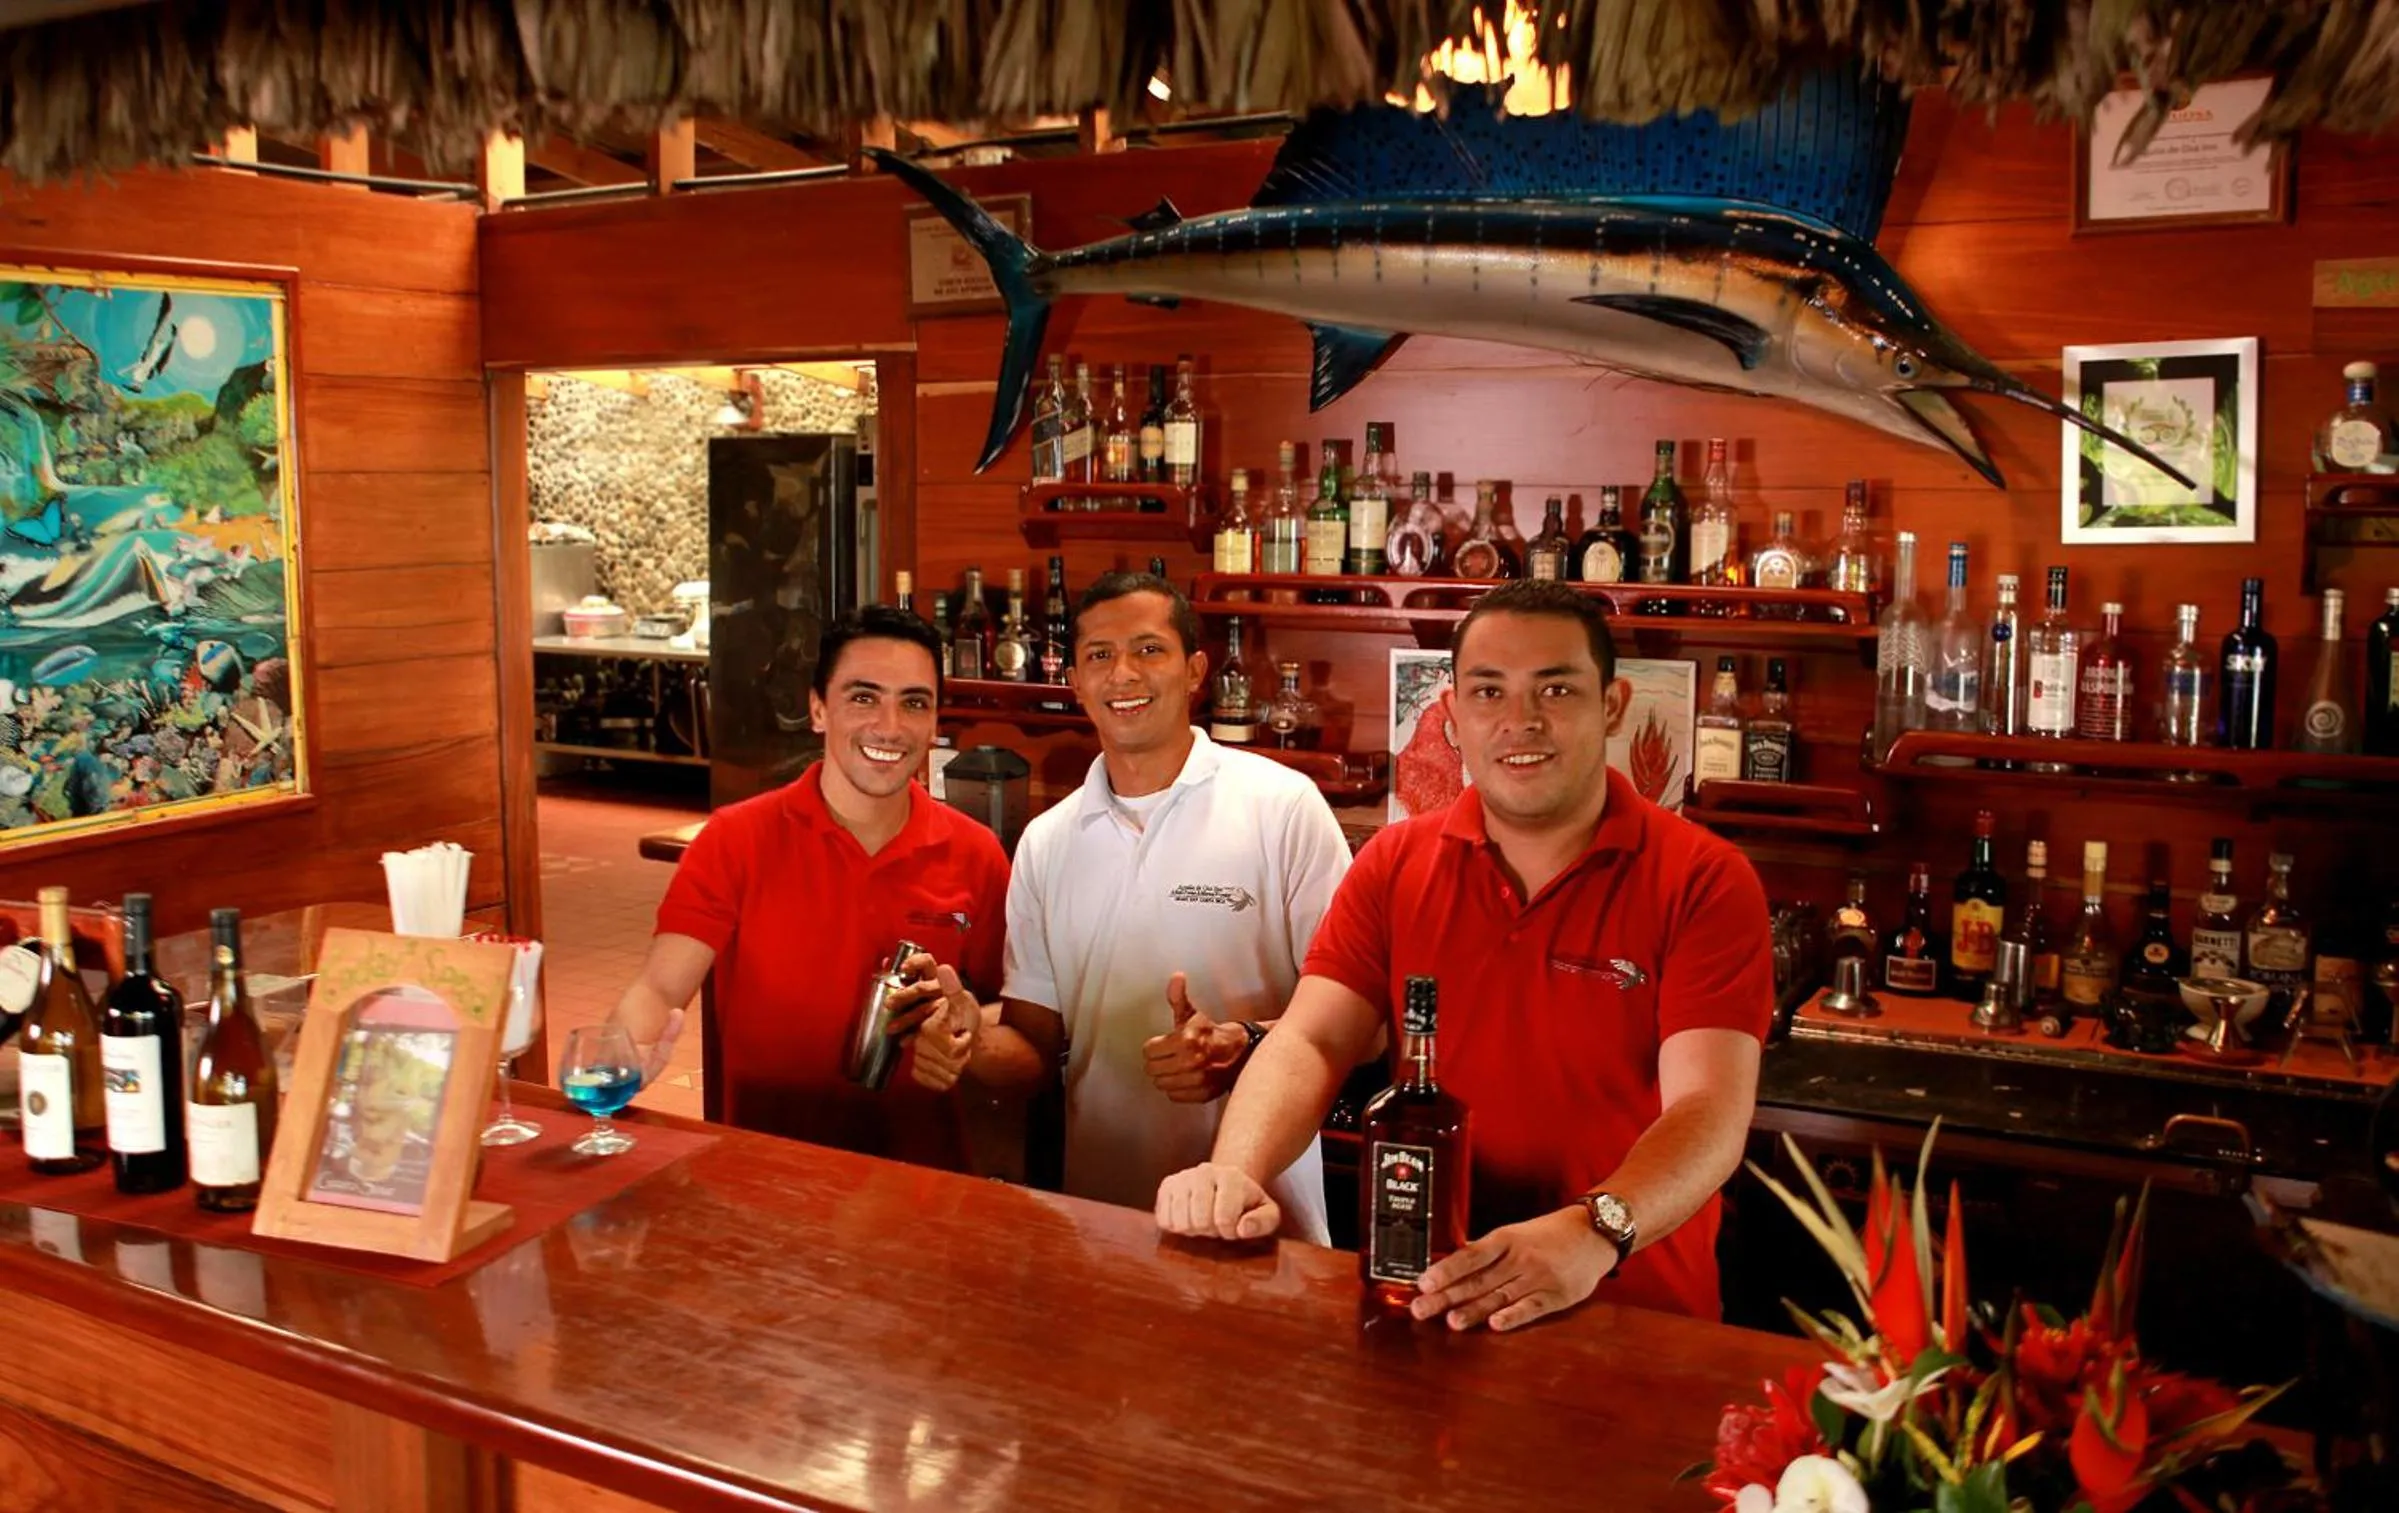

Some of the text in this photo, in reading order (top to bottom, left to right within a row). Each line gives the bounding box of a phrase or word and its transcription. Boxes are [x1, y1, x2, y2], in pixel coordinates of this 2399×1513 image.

[1381, 1151, 1424, 1172] JIM BEAM
[1385, 1179, 1420, 1192] BLACK
